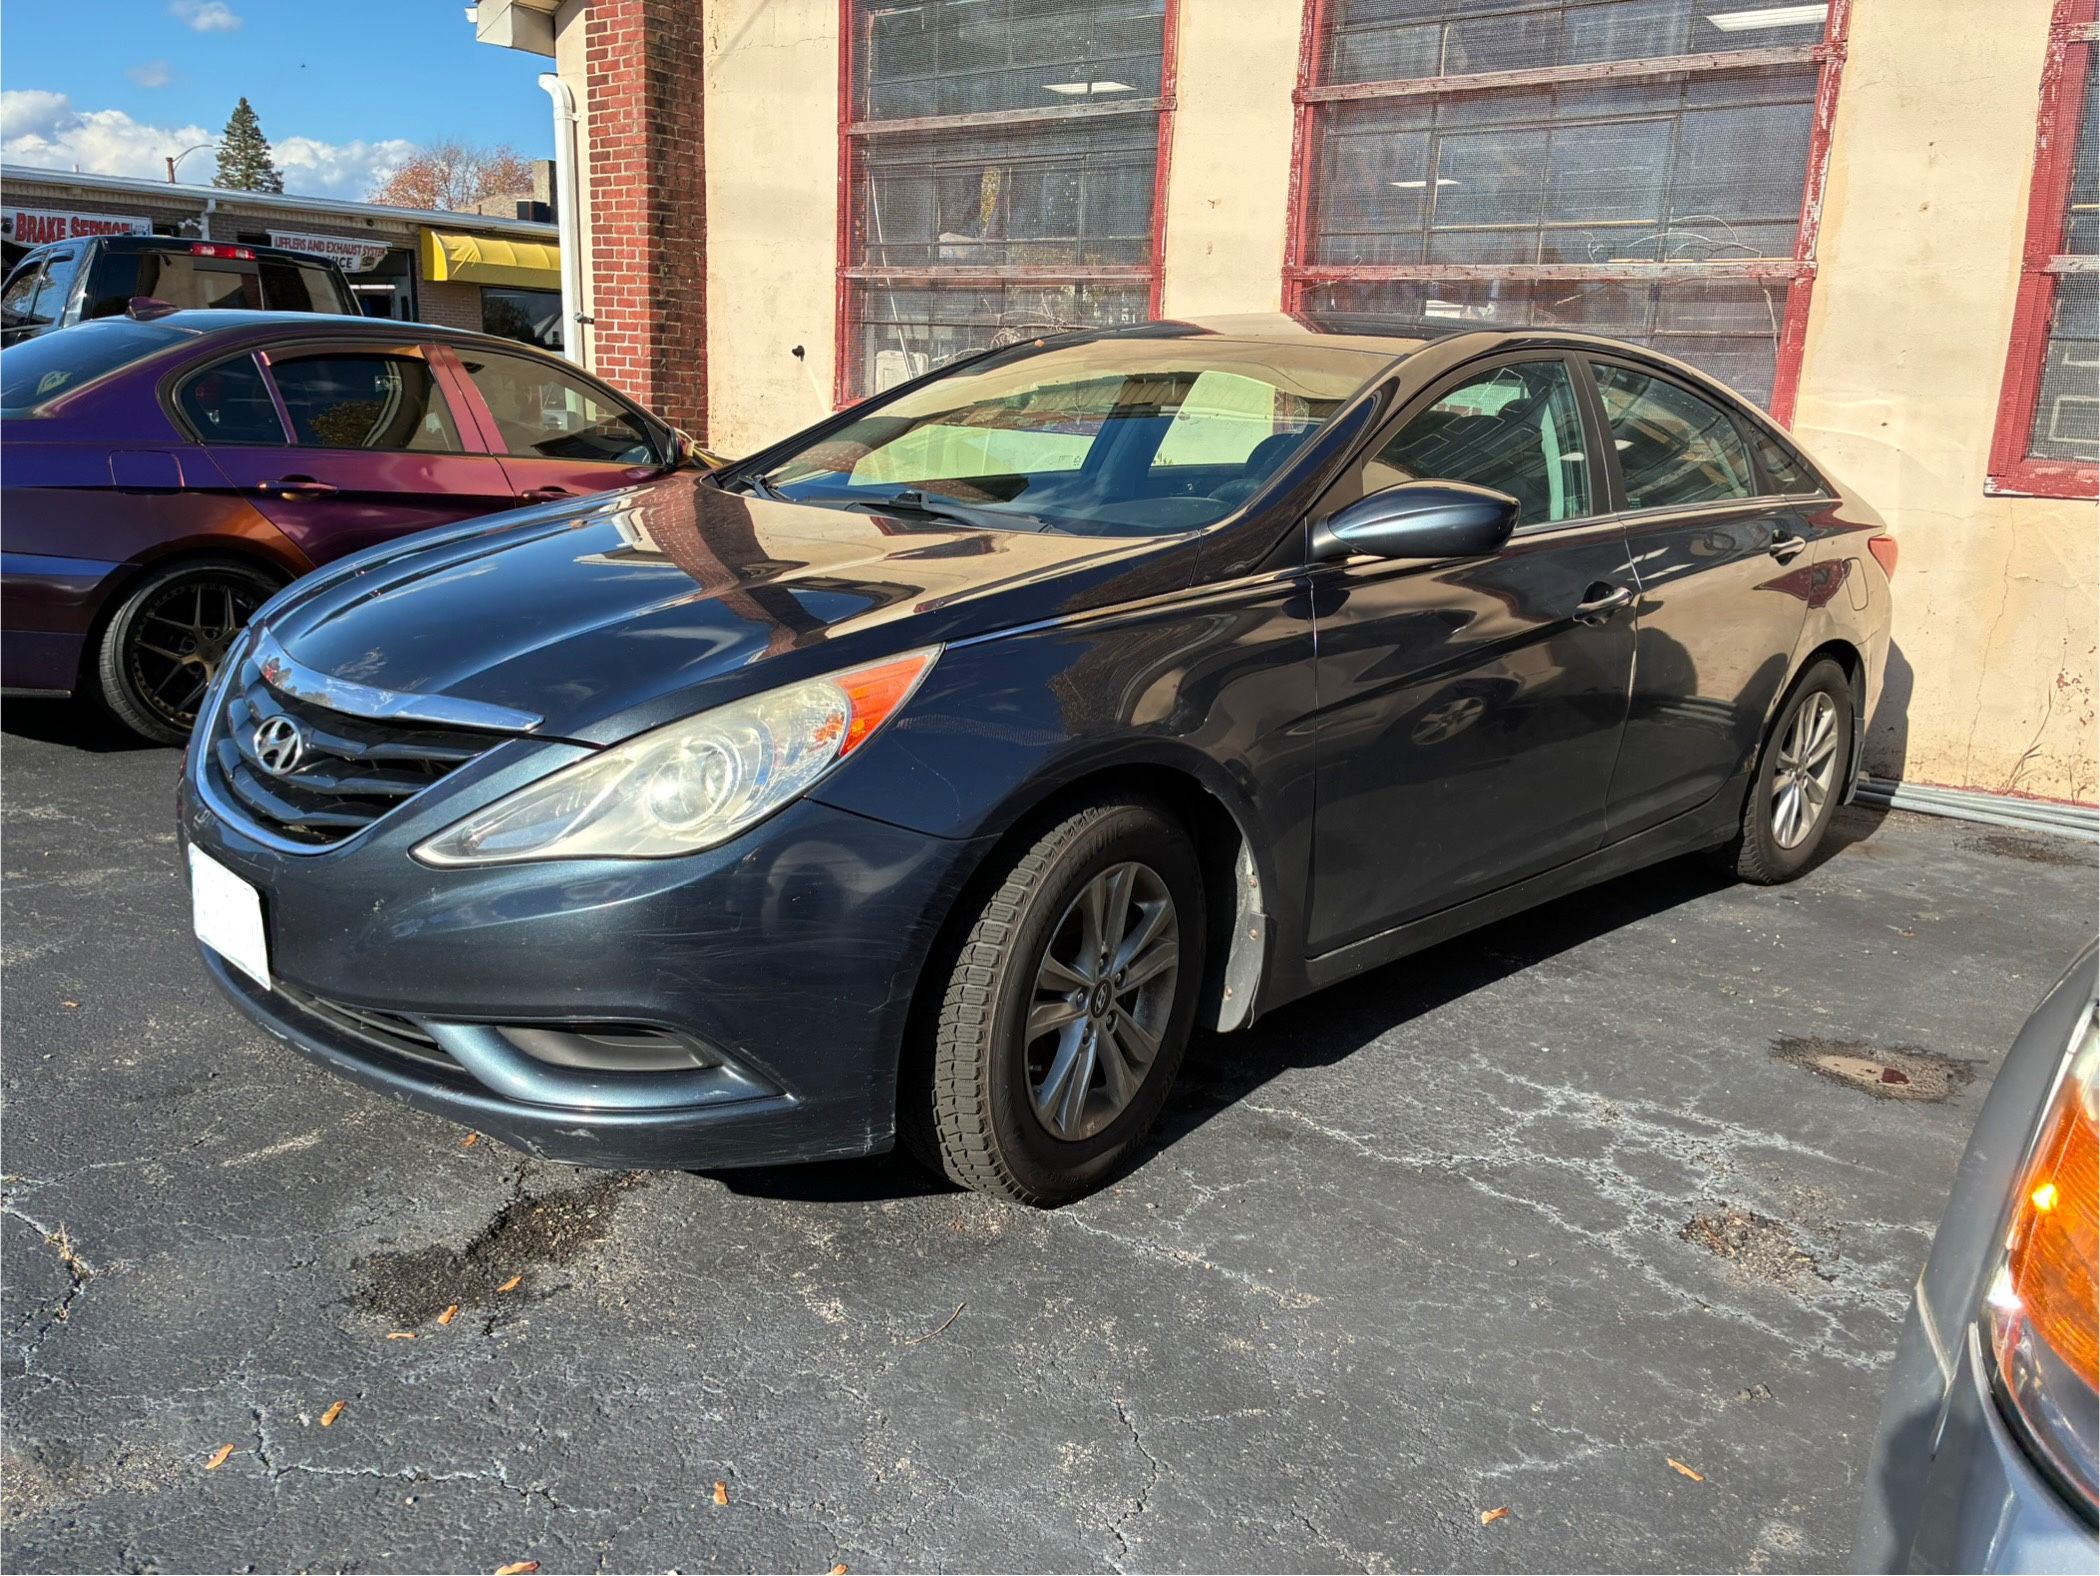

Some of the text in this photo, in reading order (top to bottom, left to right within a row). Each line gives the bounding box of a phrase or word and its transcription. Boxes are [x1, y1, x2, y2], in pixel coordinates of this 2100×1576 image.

[15, 213, 67, 243] BRAKE
[308, 239, 325, 252] AND
[327, 241, 361, 255] EXHAUST
